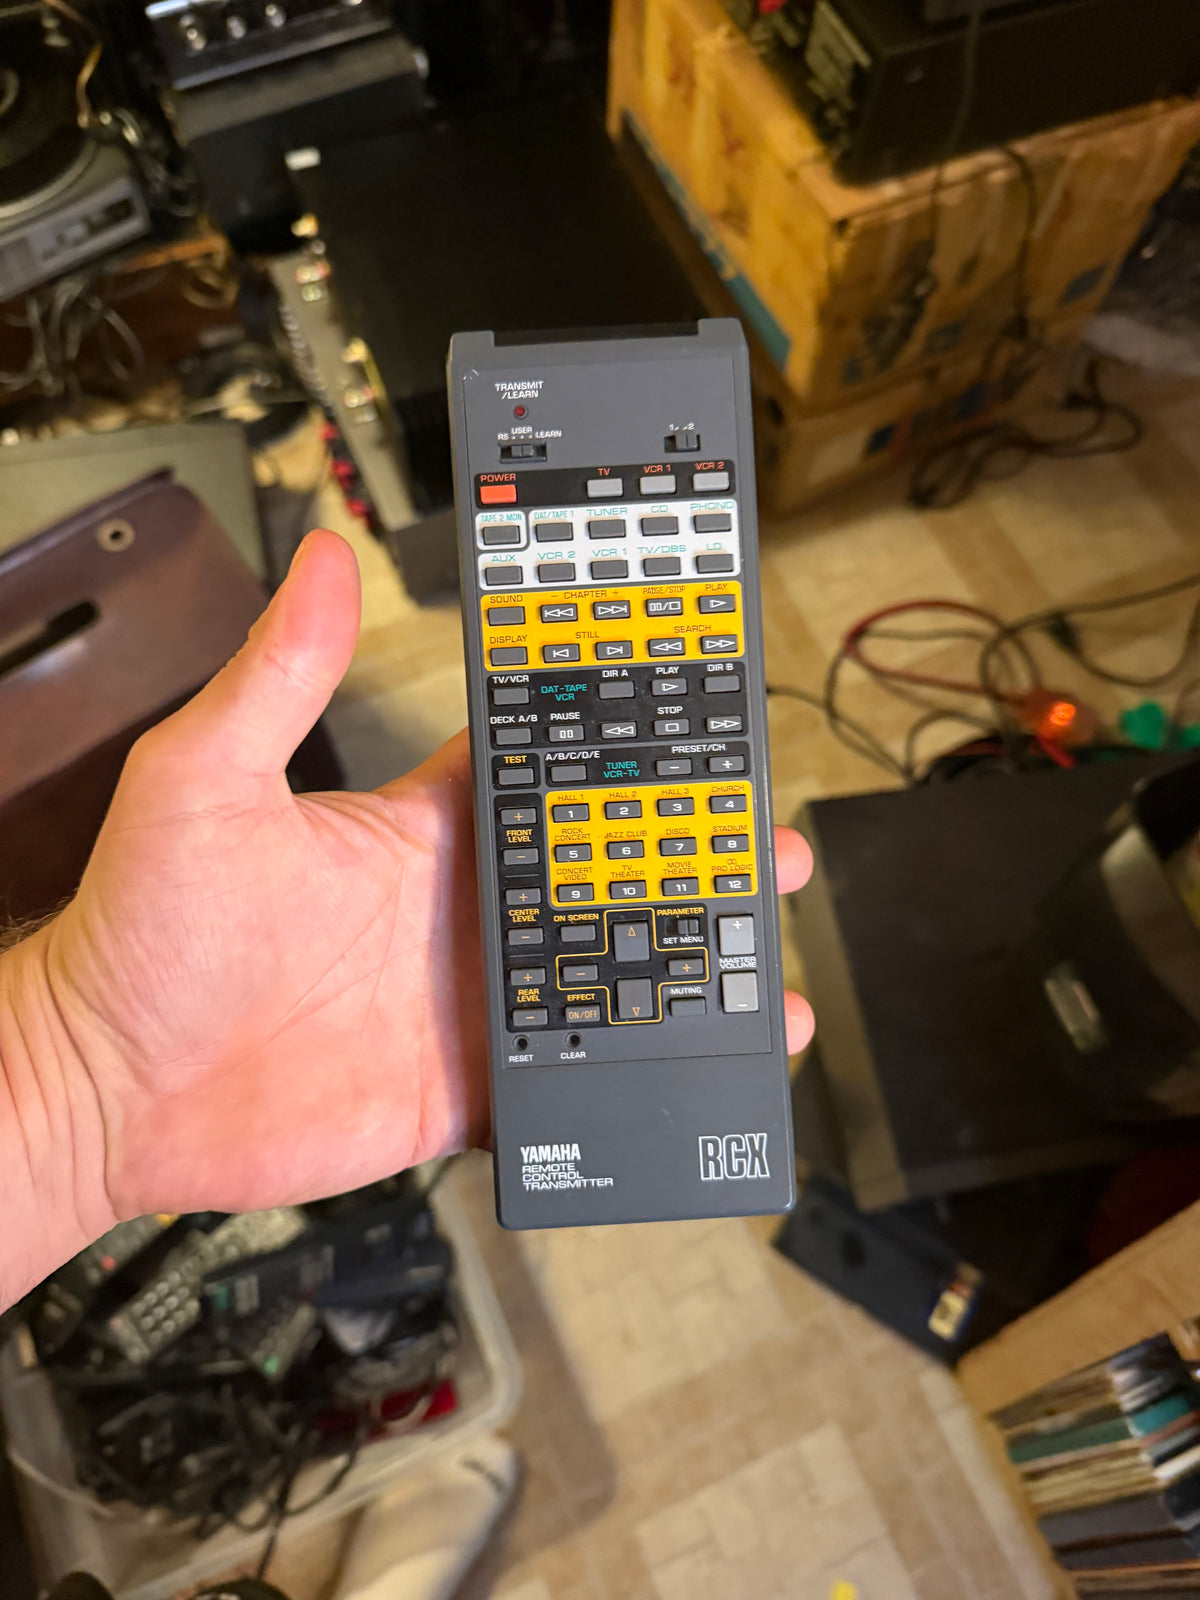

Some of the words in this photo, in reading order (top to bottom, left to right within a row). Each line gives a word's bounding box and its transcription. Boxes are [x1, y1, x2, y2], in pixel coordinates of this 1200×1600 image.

[494, 381, 544, 392] TRANSMIT
[502, 390, 538, 400] /LEARN
[535, 430, 562, 438] LEARN
[644, 466, 663, 474] VCR
[694, 462, 714, 470] VCR
[717, 462, 724, 470] 2
[480, 474, 516, 482] POWER
[690, 502, 734, 510] PHONO
[534, 511, 568, 520] DAT/TAPE
[587, 508, 628, 516] TUNER
[592, 549, 617, 557] VCR
[638, 544, 686, 554] TV/DBS
[538, 552, 563, 560] VCR
[568, 550, 575, 558] 2
[706, 584, 728, 592] PLAY
[490, 594, 523, 604] SOUND
[564, 590, 606, 600] CHAPTER
[674, 624, 712, 634] SEARCH
[576, 631, 600, 639] STILL
[490, 635, 528, 644] DISPLAY
[656, 666, 680, 674] PLAY
[707, 664, 724, 672] DIR
[602, 670, 618, 678] DIR
[492, 675, 529, 684] TV/VCR
[540, 684, 588, 694] DAT-TAPE
[554, 693, 575, 702] VCR
[656, 706, 683, 714] STOP
[490, 716, 515, 724] DECK
[518, 714, 538, 722] A/B
[550, 712, 580, 720] PAUSE
[671, 744, 726, 754] PRESET/CH
[546, 750, 600, 760] A/B/C/D/E
[504, 756, 527, 764] TEST
[606, 761, 637, 770] TUNER
[603, 769, 640, 778] VCR-TV
[620, 806, 628, 815] 2
[508, 835, 532, 843] LEVEL
[622, 847, 631, 855] 6
[675, 843, 684, 851] 7
[569, 850, 578, 858] 5
[556, 867, 592, 875] CONCERT
[728, 880, 742, 888] 12
[572, 890, 580, 898] 9
[622, 888, 636, 896] 10
[656, 907, 704, 916] PARAMETER
[670, 986, 702, 995] MUTING
[567, 994, 596, 1002] EFFECT
[568, 1010, 598, 1019] ON/OFF
[508, 1054, 534, 1062] RESET
[560, 1052, 586, 1060] CLEAR
[520, 1144, 581, 1164] YAMAHA
[698, 1133, 770, 1180] RCX
[522, 1162, 575, 1173] REMOTE
[522, 1171, 584, 1182] CONTROL
[523, 1177, 614, 1190] TRANSMITTER
